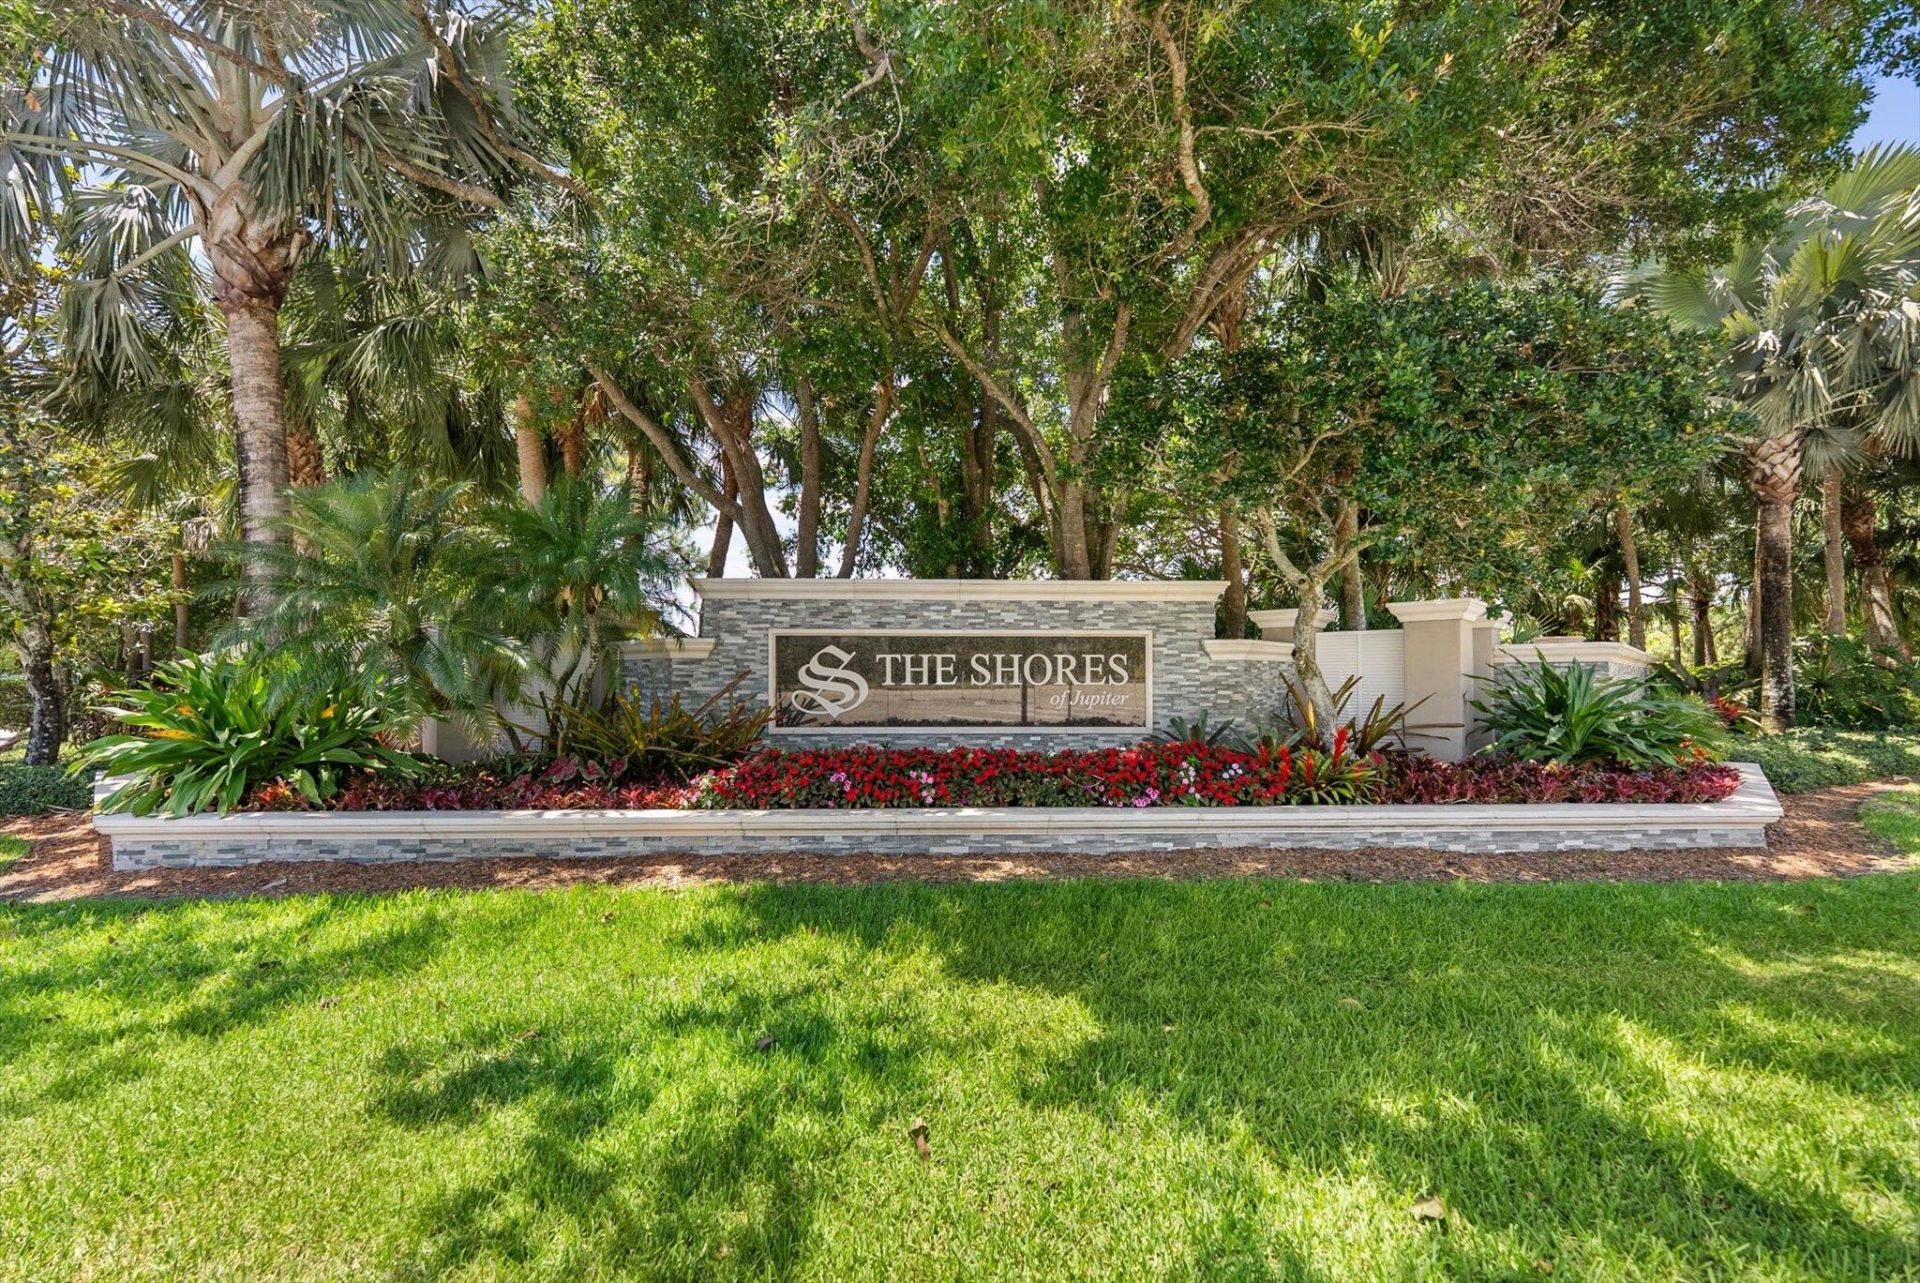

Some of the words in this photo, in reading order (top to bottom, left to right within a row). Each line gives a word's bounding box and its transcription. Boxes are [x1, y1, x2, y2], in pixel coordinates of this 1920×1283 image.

[876, 653, 957, 686] THE
[970, 653, 1129, 686] SHORES
[1050, 690, 1070, 709] of
[1069, 690, 1129, 709] Jupiter
